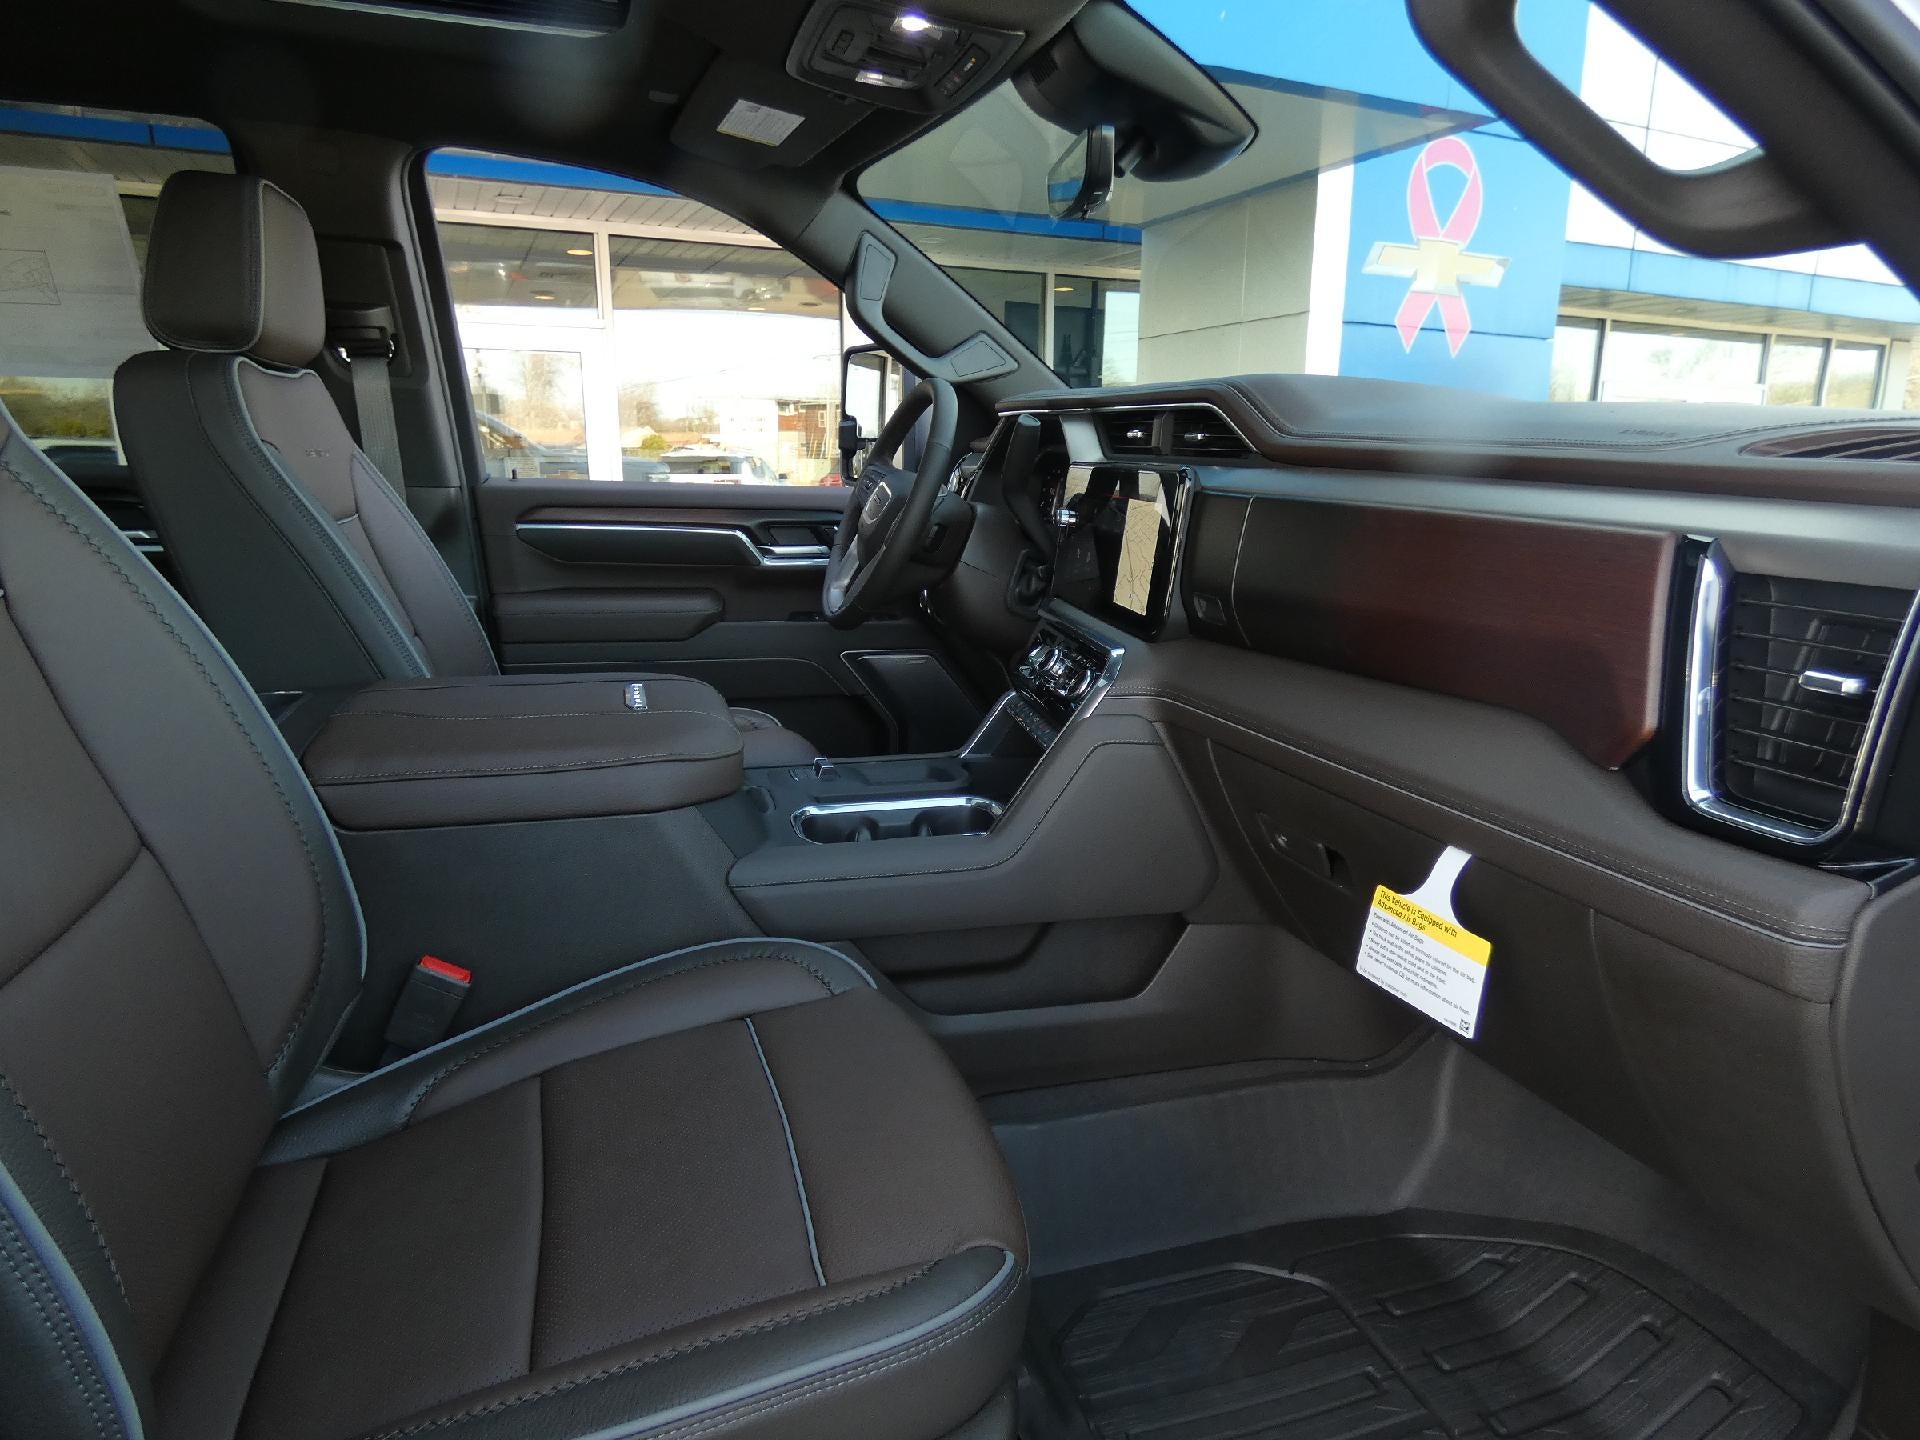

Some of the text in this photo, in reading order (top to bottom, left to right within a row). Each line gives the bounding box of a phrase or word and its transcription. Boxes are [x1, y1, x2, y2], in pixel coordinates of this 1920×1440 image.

[1378, 899, 1403, 918] Advanced
[1381, 891, 1390, 901] This
[1418, 910, 1443, 929] Equipped
